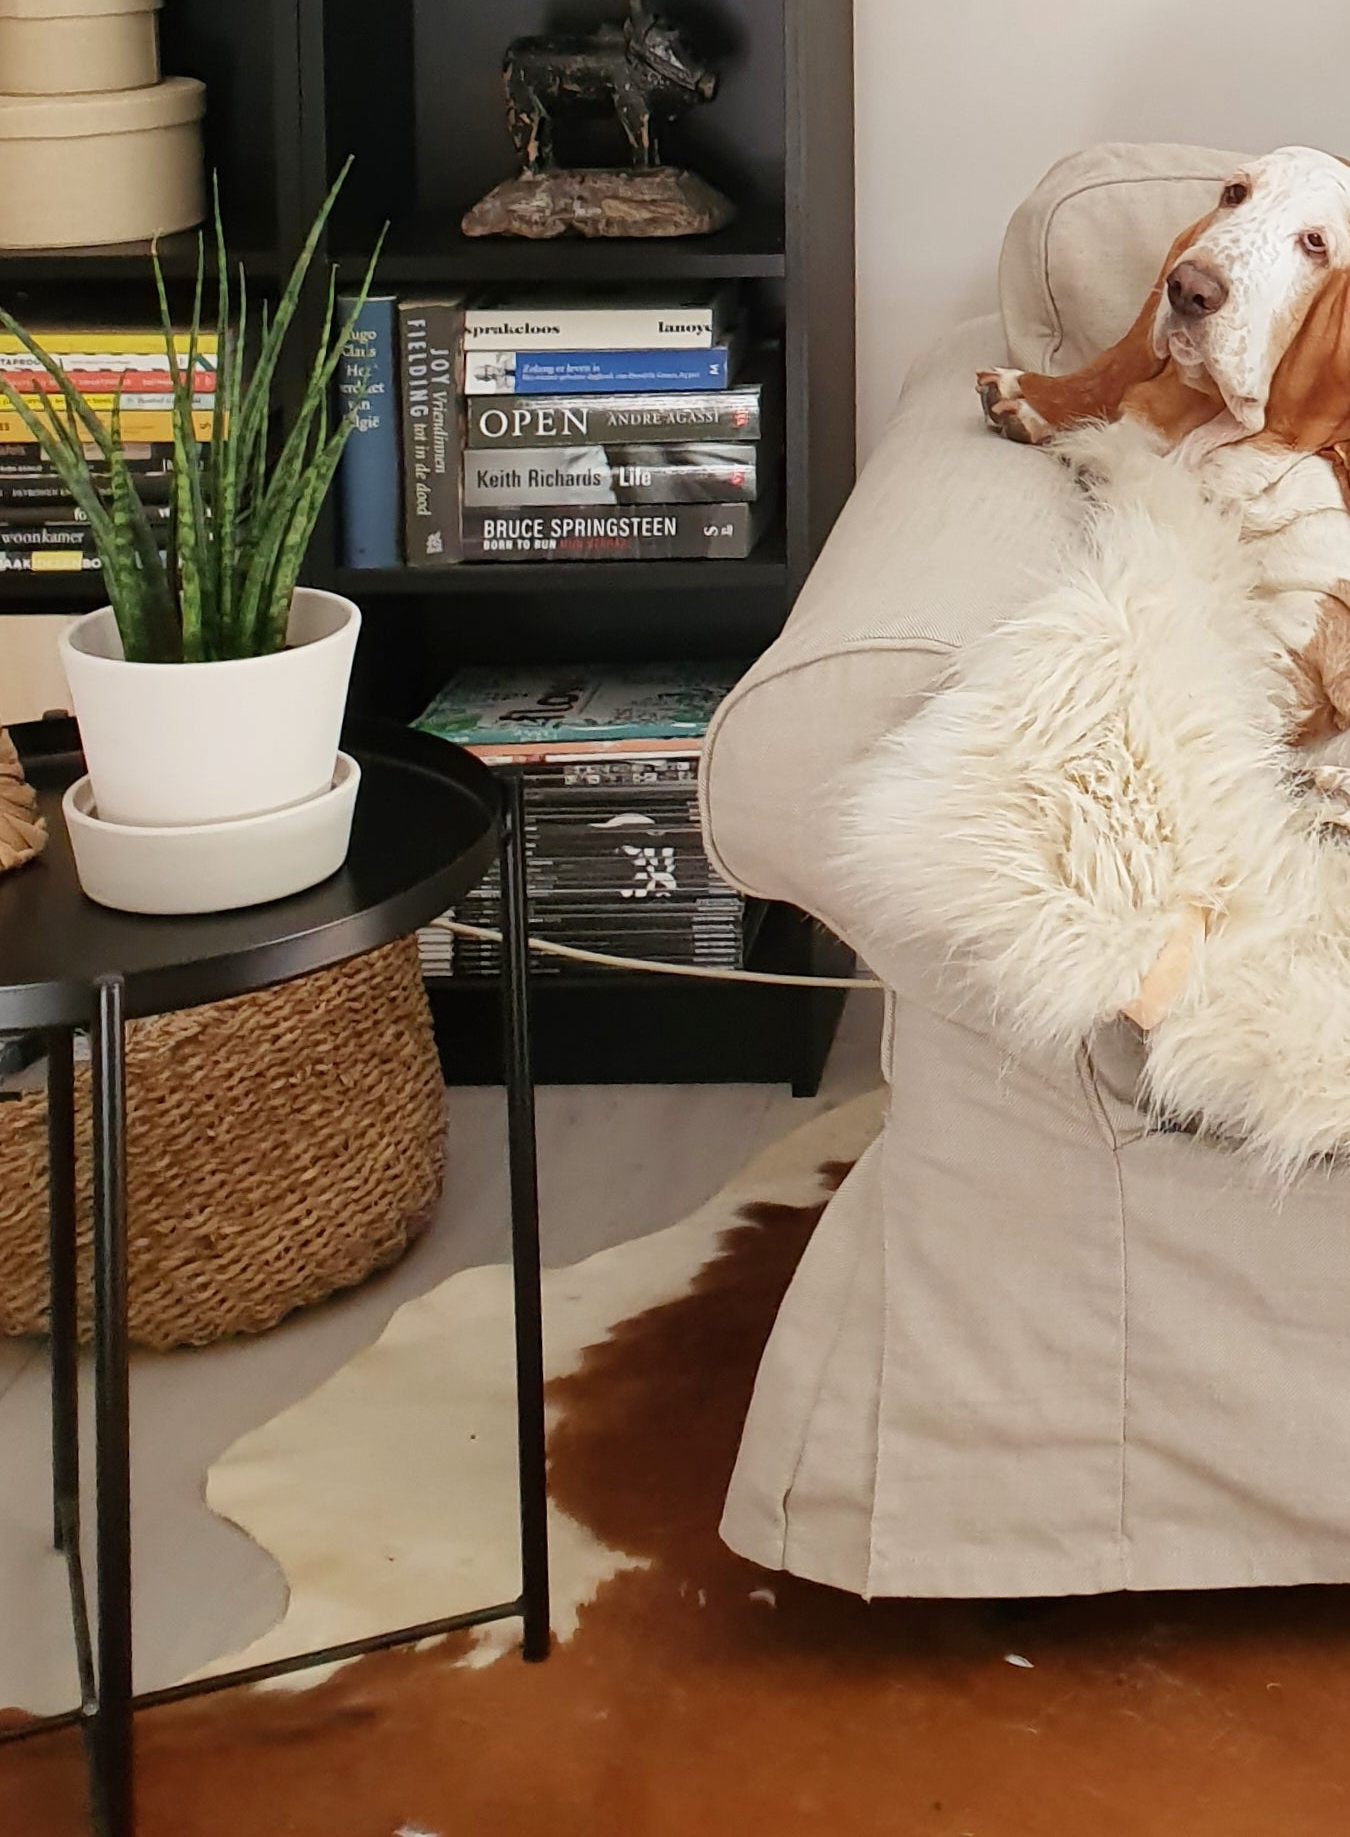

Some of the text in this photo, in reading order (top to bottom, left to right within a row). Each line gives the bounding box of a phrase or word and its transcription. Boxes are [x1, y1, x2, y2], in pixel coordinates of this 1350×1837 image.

[406, 318, 429, 418] FIELDING
[430, 347, 450, 474] JOY Vriendinnen
[479, 408, 588, 437] OPEN
[666, 409, 719, 425] AGASSI
[414, 462, 430, 480] de
[477, 466, 651, 489] Keith Richards Life
[415, 482, 433, 516] dood
[2, 528, 85, 545] woonkamer
[484, 520, 544, 538] BRUCE
[551, 517, 676, 538] SPRINGSTEEN
[483, 539, 513, 550] BORN
[517, 539, 531, 550] TO
[534, 538, 557, 550] RUN
